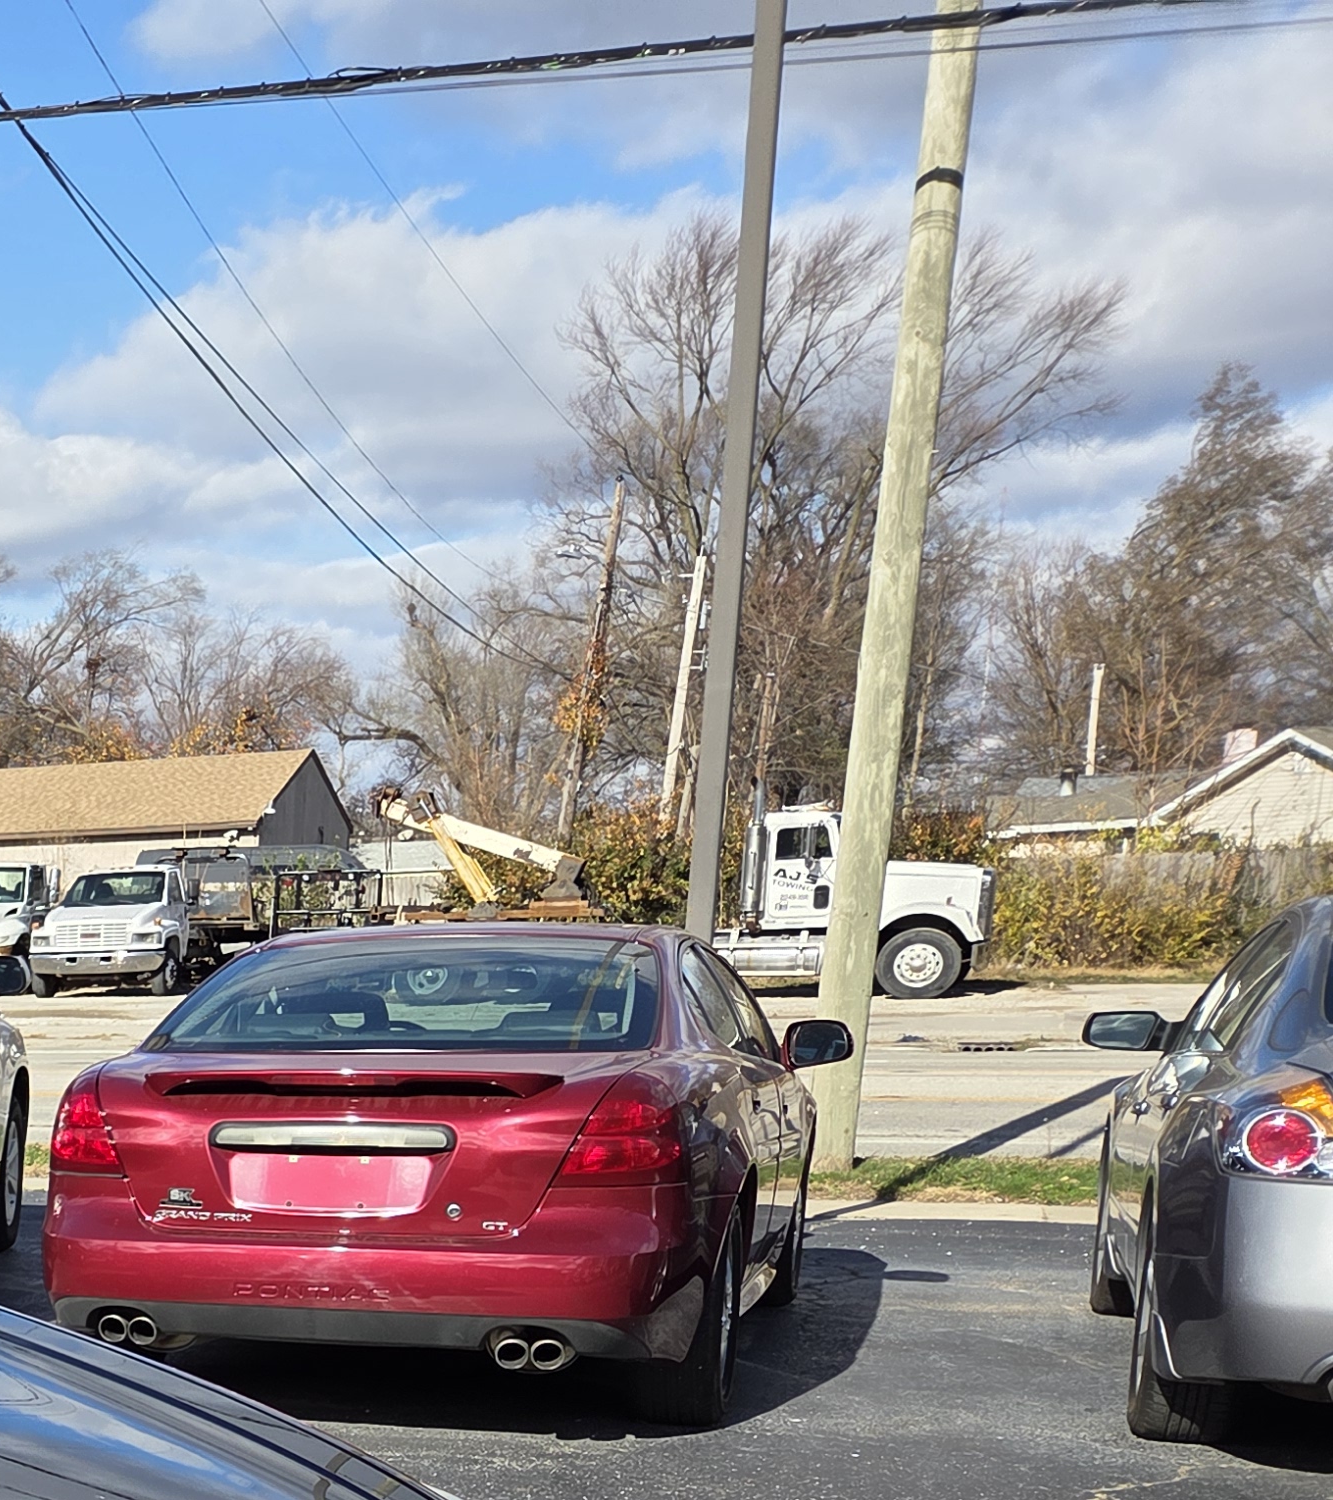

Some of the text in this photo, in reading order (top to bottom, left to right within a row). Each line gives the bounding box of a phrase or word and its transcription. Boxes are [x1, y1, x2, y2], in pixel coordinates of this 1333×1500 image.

[153, 1209, 252, 1222] GRAND PRIX
[482, 1221, 508, 1231] GT
